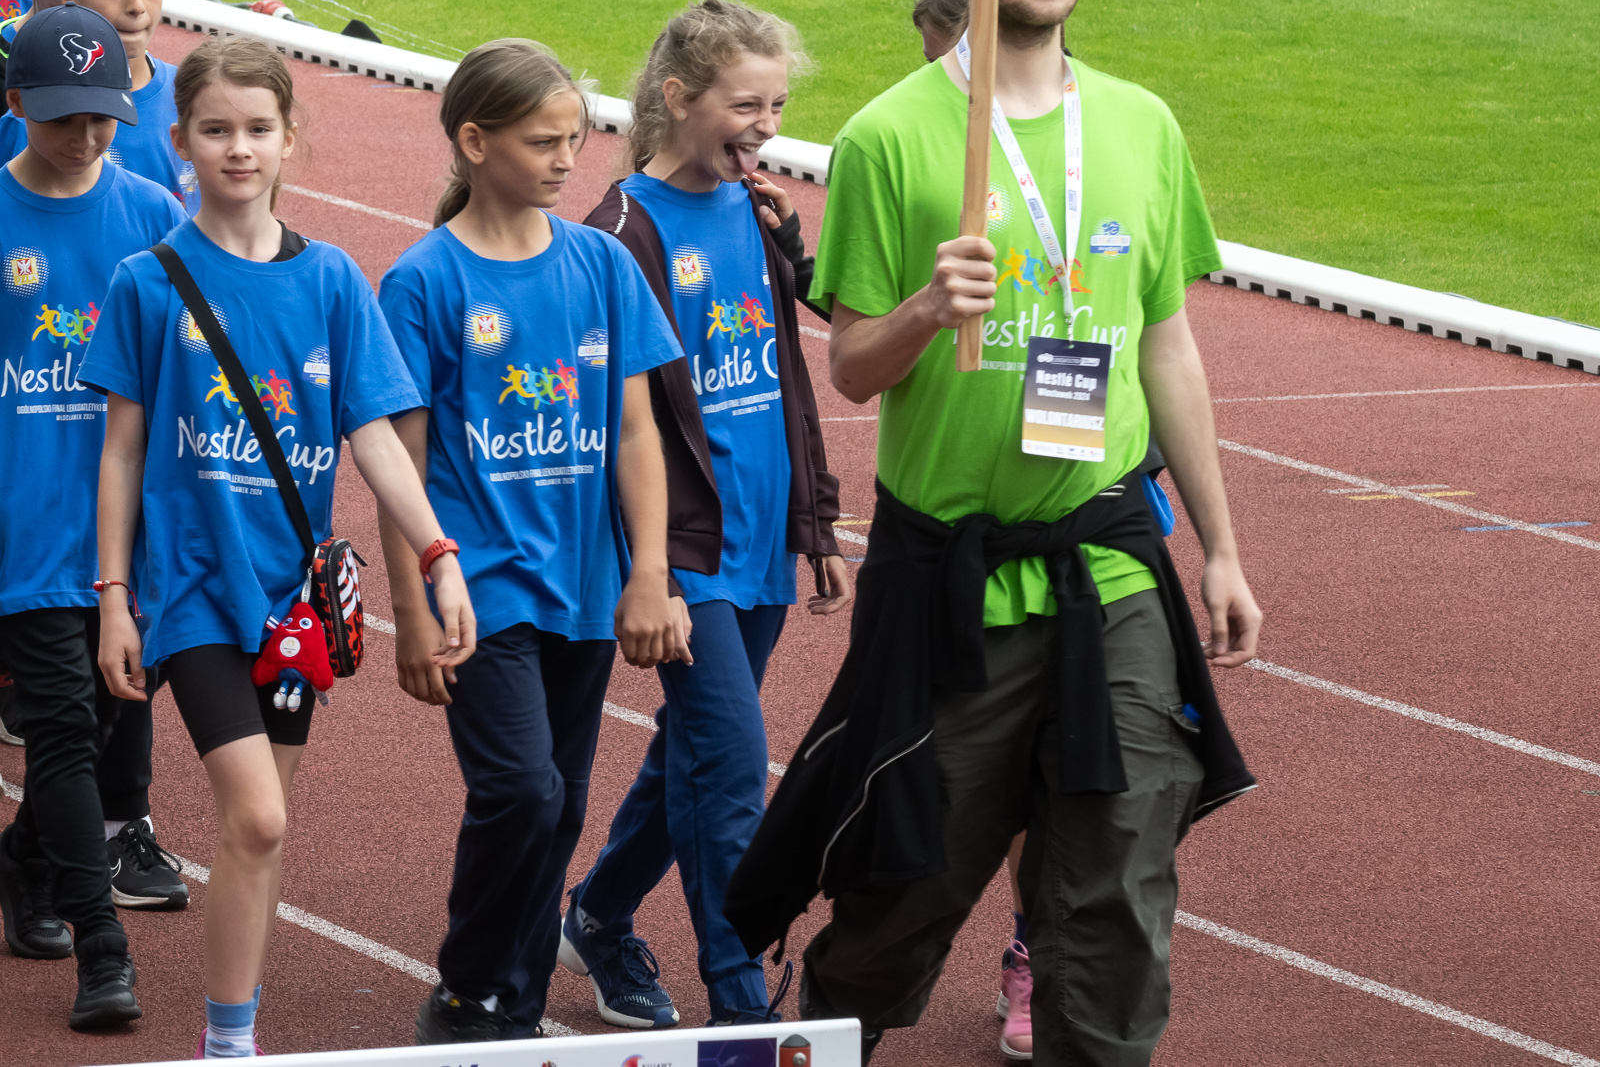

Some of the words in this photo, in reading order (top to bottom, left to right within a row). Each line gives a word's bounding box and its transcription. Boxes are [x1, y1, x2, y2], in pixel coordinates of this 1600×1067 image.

[953, 304, 1056, 348] estlé
[1072, 305, 1127, 368] Cup
[691, 345, 757, 395] Nestlé
[1035, 370, 1073, 387] Nestlé
[1074, 374, 1097, 391] Cup
[177, 415, 262, 463] Nestlé
[276, 425, 334, 485] Cup
[464, 413, 568, 462] Nestlé
